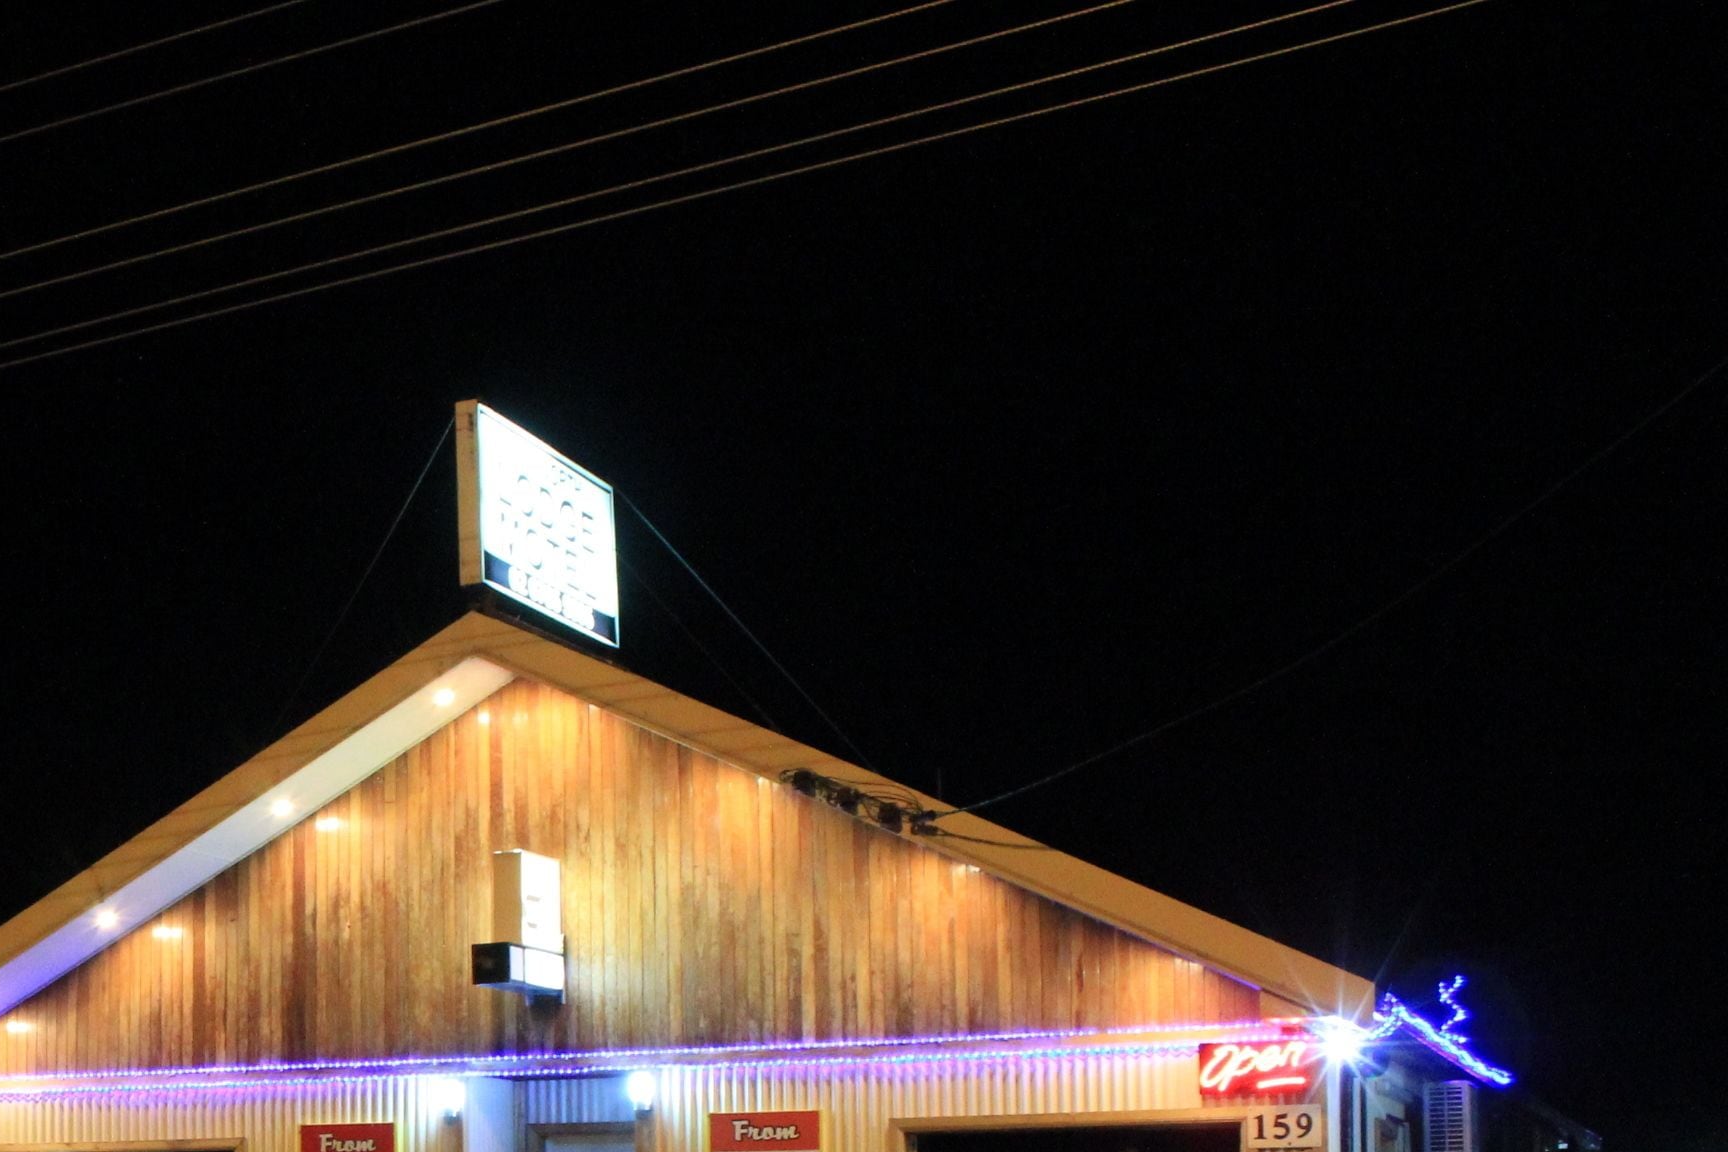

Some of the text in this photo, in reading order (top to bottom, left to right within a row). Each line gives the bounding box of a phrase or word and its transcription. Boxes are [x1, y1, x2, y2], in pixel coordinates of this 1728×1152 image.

[1200, 1041, 1307, 1091] Open
[732, 1120, 800, 1141] From
[1254, 1113, 1313, 1140] 159
[319, 1133, 376, 1152] From
